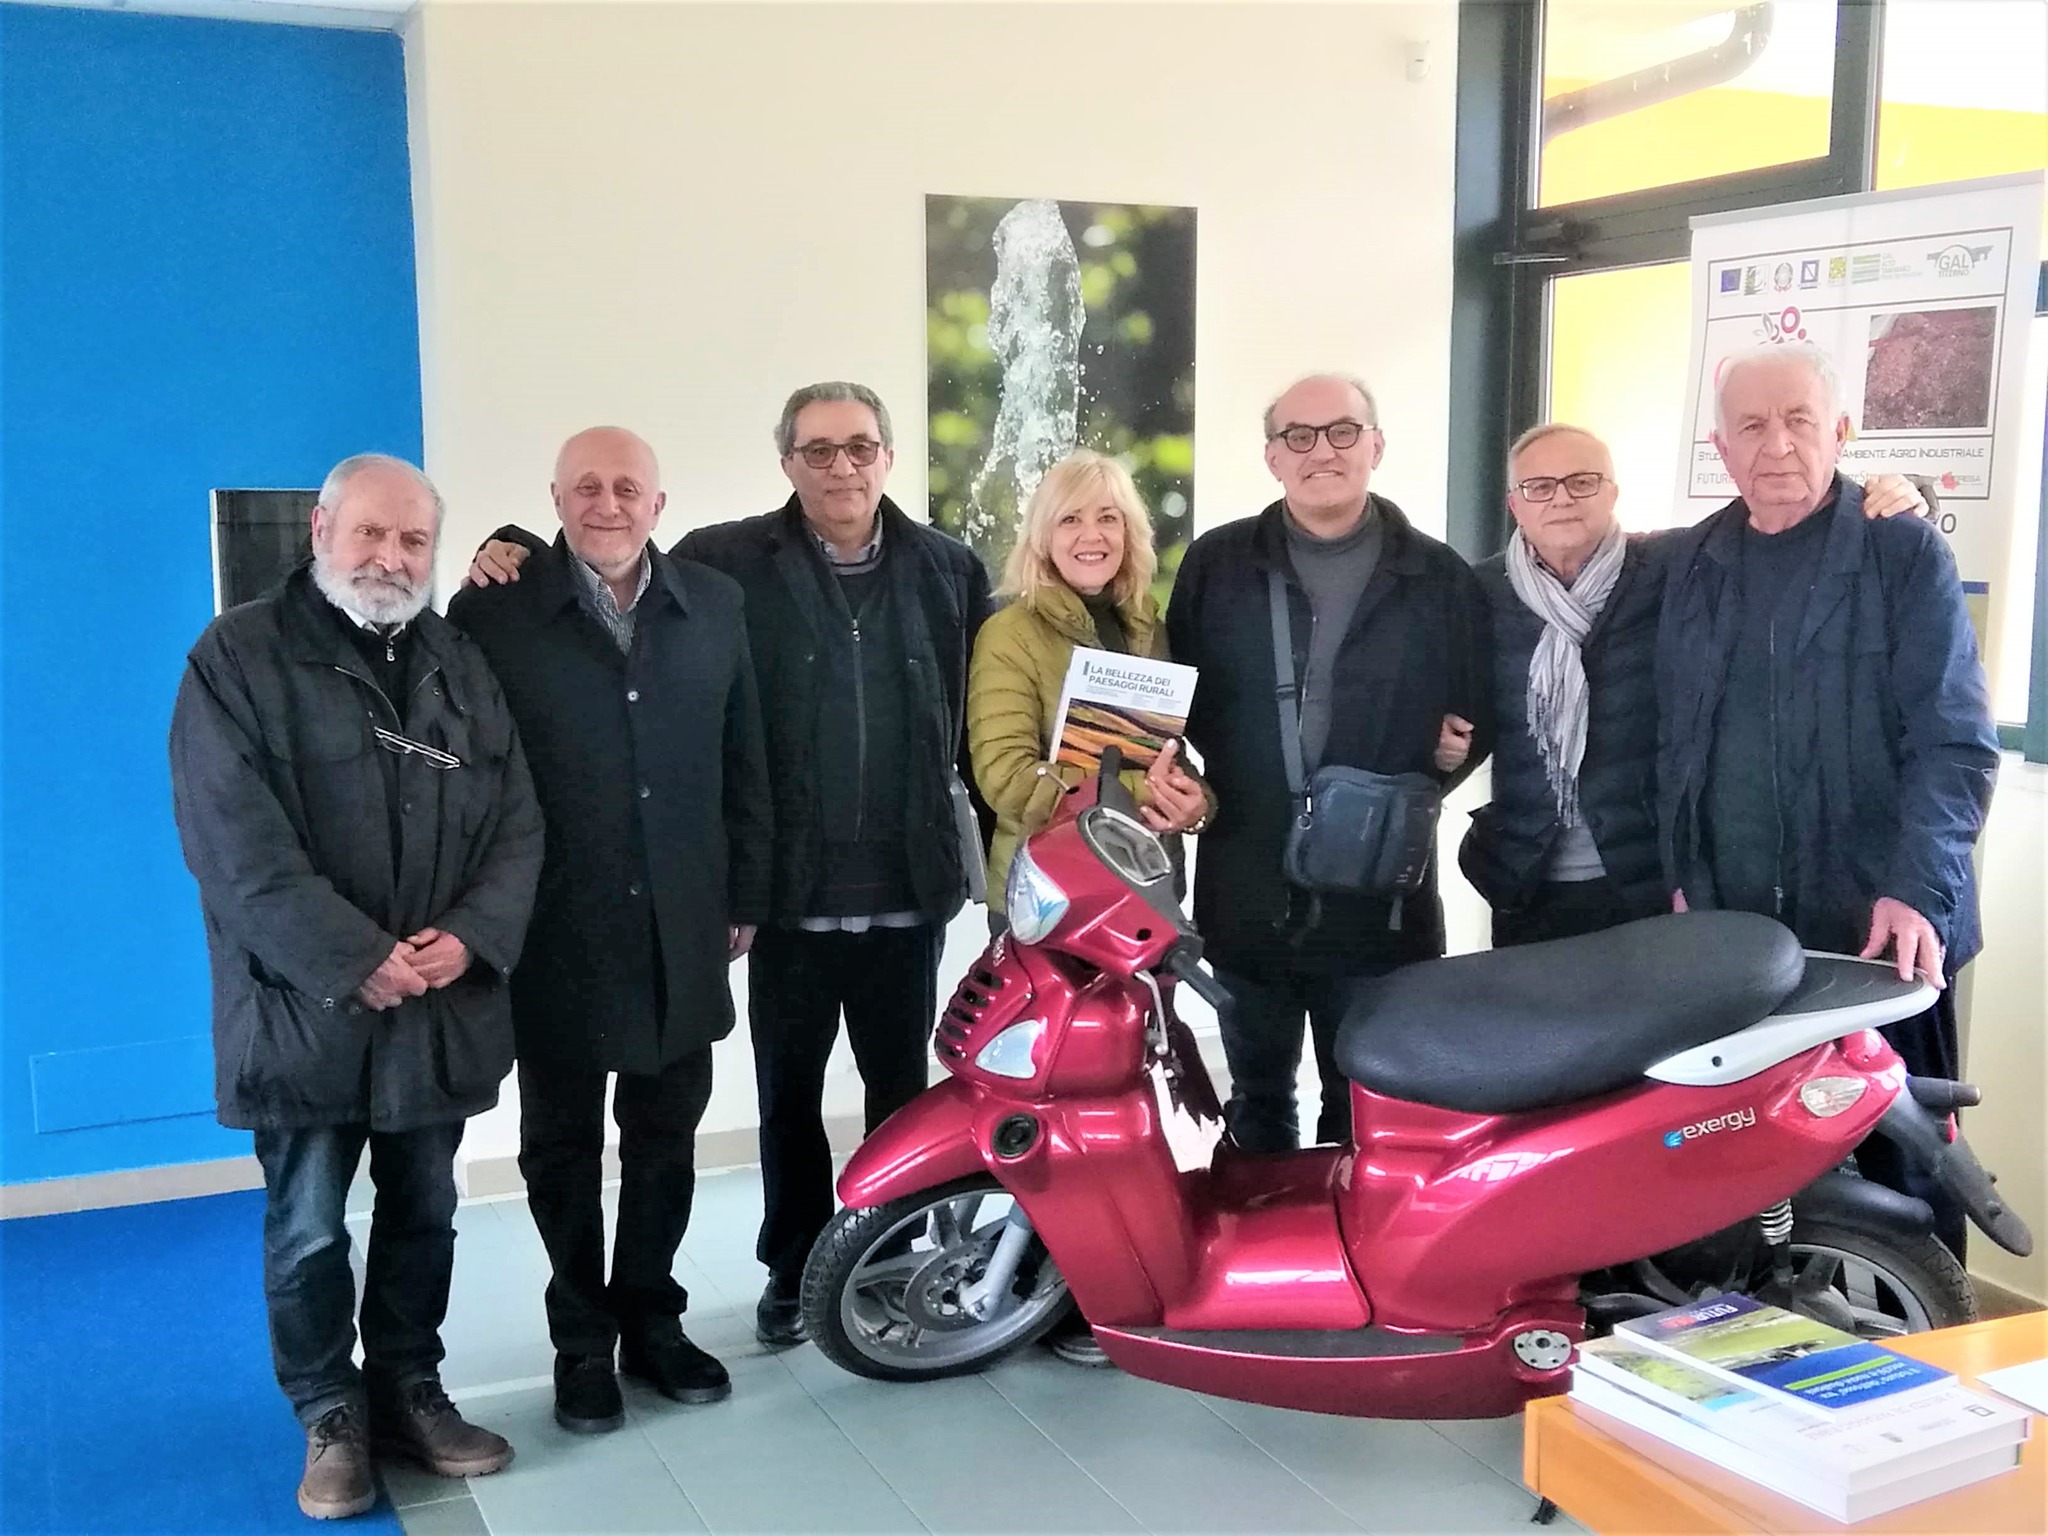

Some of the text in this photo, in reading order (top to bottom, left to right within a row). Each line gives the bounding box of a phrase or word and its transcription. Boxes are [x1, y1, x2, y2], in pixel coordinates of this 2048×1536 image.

[1939, 254, 1969, 270] GAL
[1938, 269, 1969, 278] TITERNO
[1698, 447, 1984, 461] STUD AMBIENTE AGRO INDUSTRIALE
[1697, 473, 1729, 484] FUTUR
[1090, 665, 1171, 687] LA BELLEZZA DEI
[1089, 675, 1139, 692] PAESAGGI
[1139, 684, 1174, 697] RURALI
[1683, 1107, 1756, 1139] exergy
